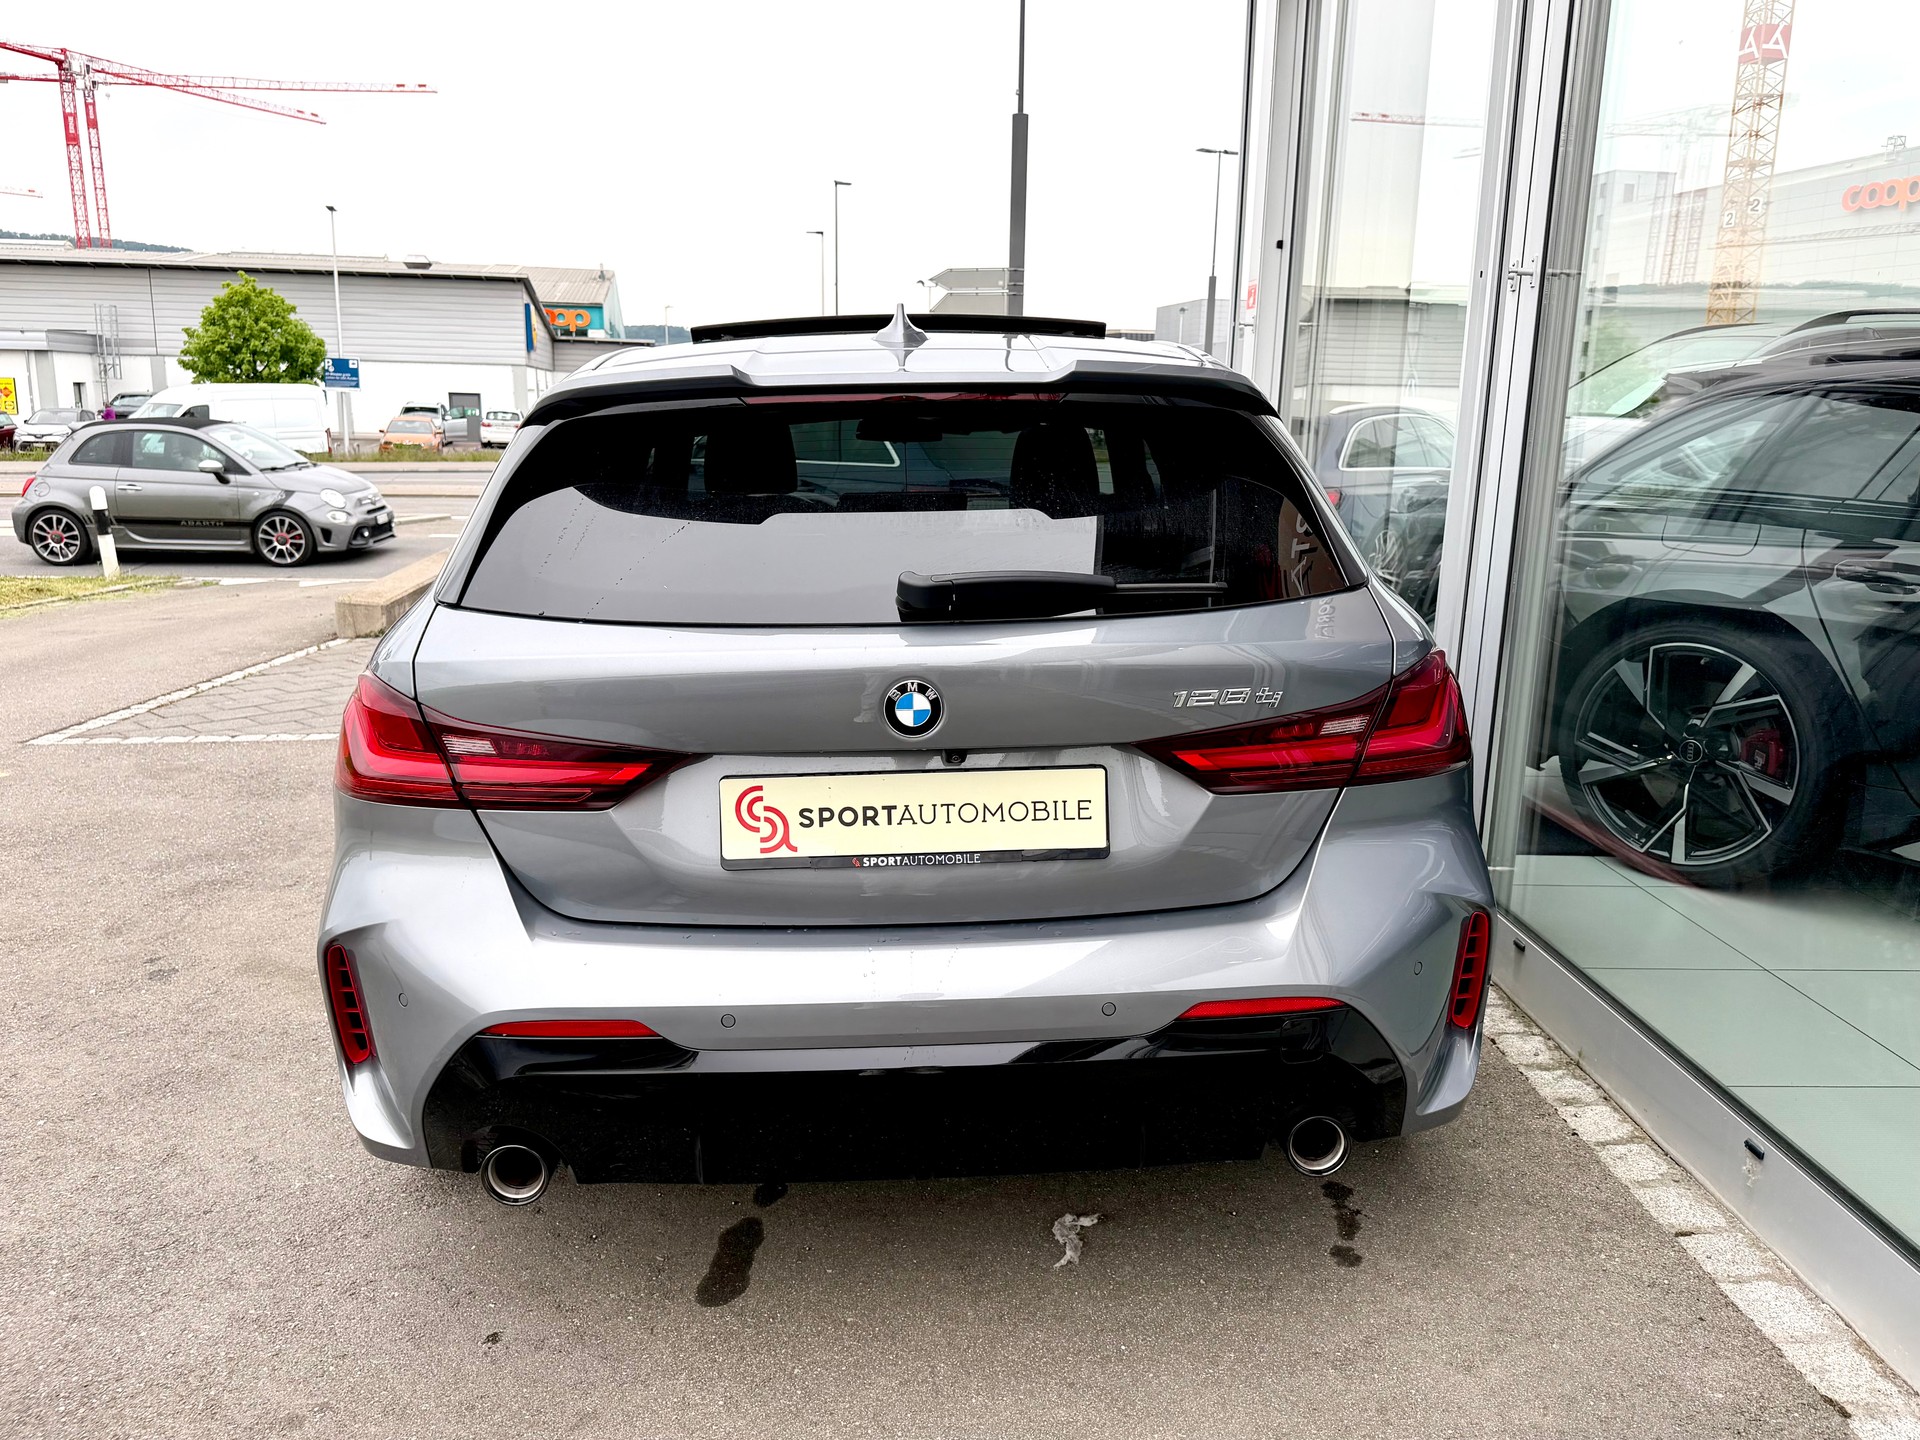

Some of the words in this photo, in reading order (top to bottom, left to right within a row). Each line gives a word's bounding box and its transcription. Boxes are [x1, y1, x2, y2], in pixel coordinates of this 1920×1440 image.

[1841, 175, 1920, 212] coop
[1724, 212, 1734, 226] 2
[889, 682, 938, 701] BMW
[798, 800, 1092, 828] SPORTAUTOMOBILE
[863, 853, 981, 867] SPORTAUTOMOBILE
